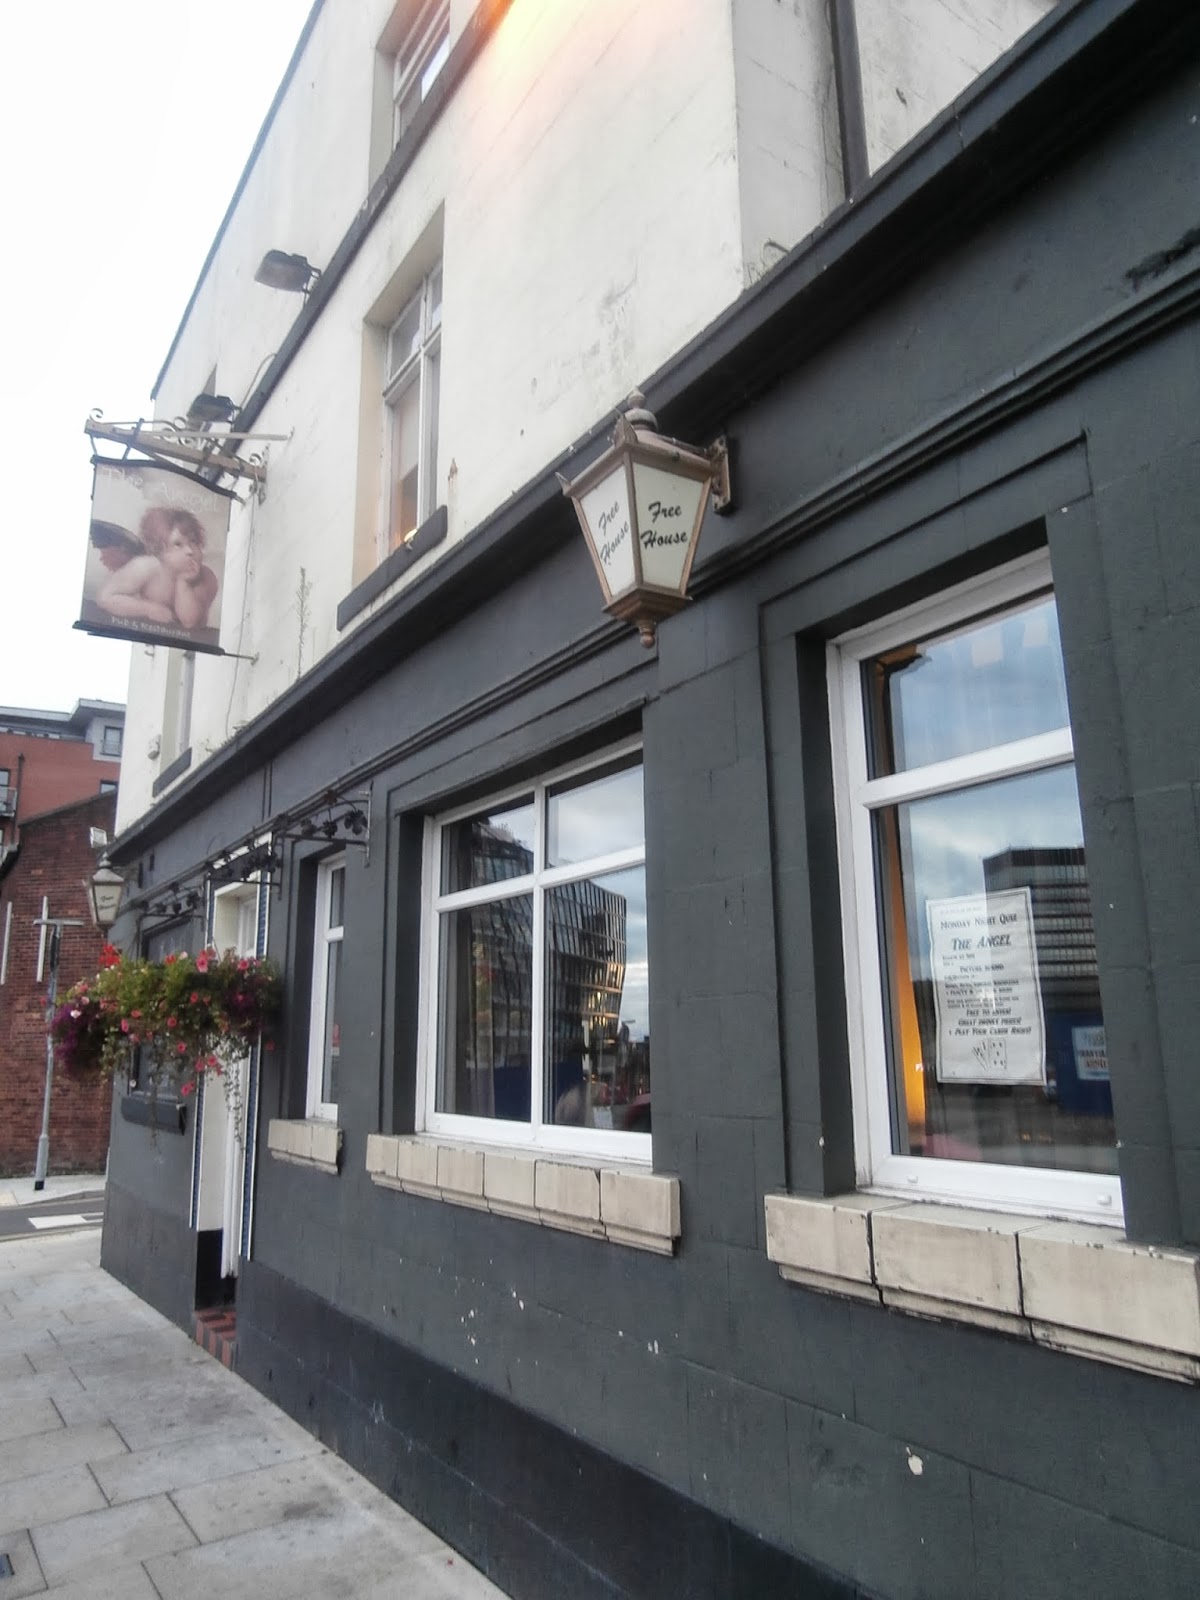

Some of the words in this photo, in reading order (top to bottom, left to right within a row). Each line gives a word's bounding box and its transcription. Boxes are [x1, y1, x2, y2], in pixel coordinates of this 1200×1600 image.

[598, 501, 620, 536] Free
[648, 501, 683, 523] Free
[600, 521, 630, 566] House
[640, 530, 688, 550] House
[951, 936, 972, 951] THE
[977, 934, 1012, 949] ANGEL
